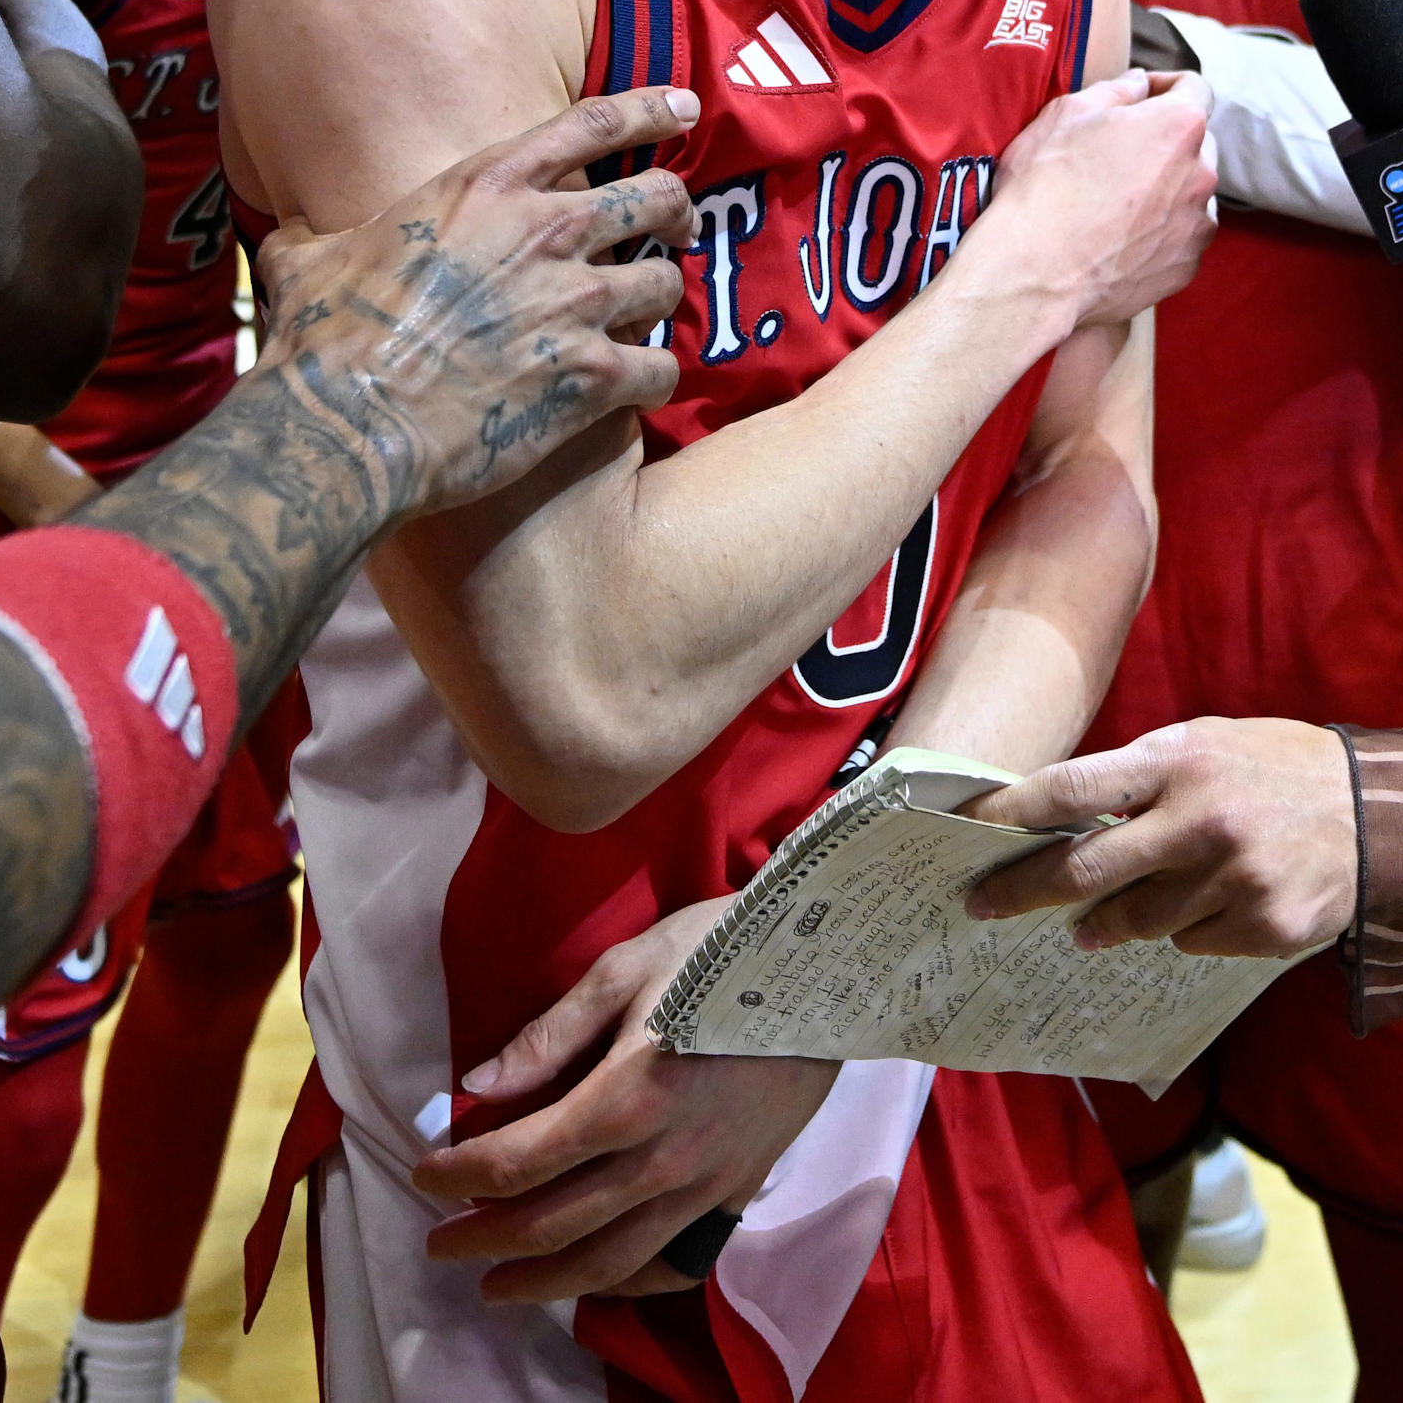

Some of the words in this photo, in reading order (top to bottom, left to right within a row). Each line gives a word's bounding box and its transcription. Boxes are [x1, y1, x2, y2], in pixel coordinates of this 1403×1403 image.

[992, 19, 1054, 42] EAST
[166, 163, 232, 271] 4
[628, 172, 785, 366] T.
[841, 908, 899, 968] thought
[1001, 925, 1060, 976] Kansas
[777, 965, 830, 1019] trailed
[819, 977, 858, 1021] walked
[829, 1007, 865, 1039] Rick
[893, 931, 925, 961] still
